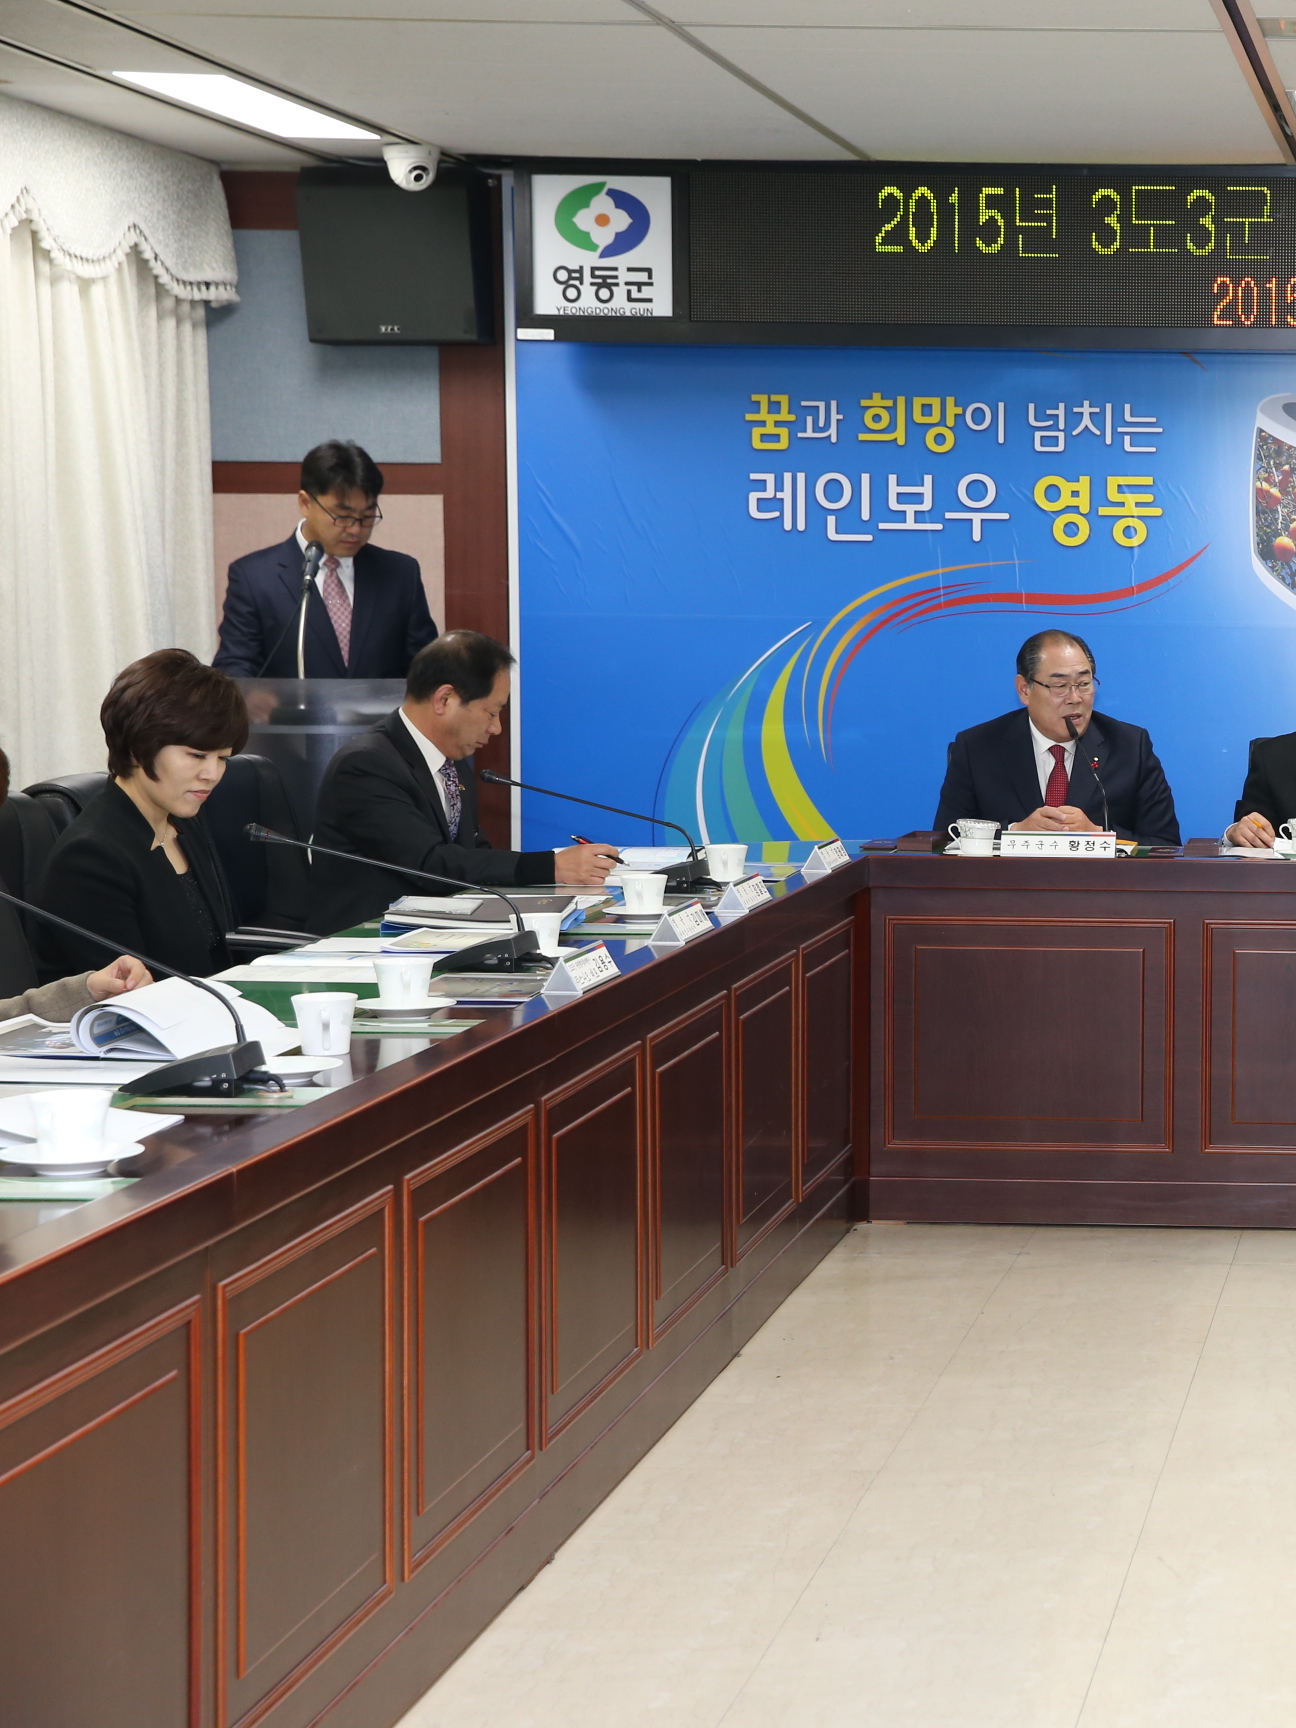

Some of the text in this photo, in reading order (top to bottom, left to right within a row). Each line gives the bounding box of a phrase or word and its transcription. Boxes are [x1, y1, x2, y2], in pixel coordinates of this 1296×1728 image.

[875, 185, 1058, 258] 2015년
[1090, 185, 1272, 261] 3도3군
[552, 265, 654, 304] 영동군
[556, 306, 654, 317] YEONGDONG GUN
[745, 391, 1164, 455] 꿈과 희망이 넘치는
[747, 472, 1163, 548] 레인보우 영동
[1068, 839, 1111, 852] 황정수
